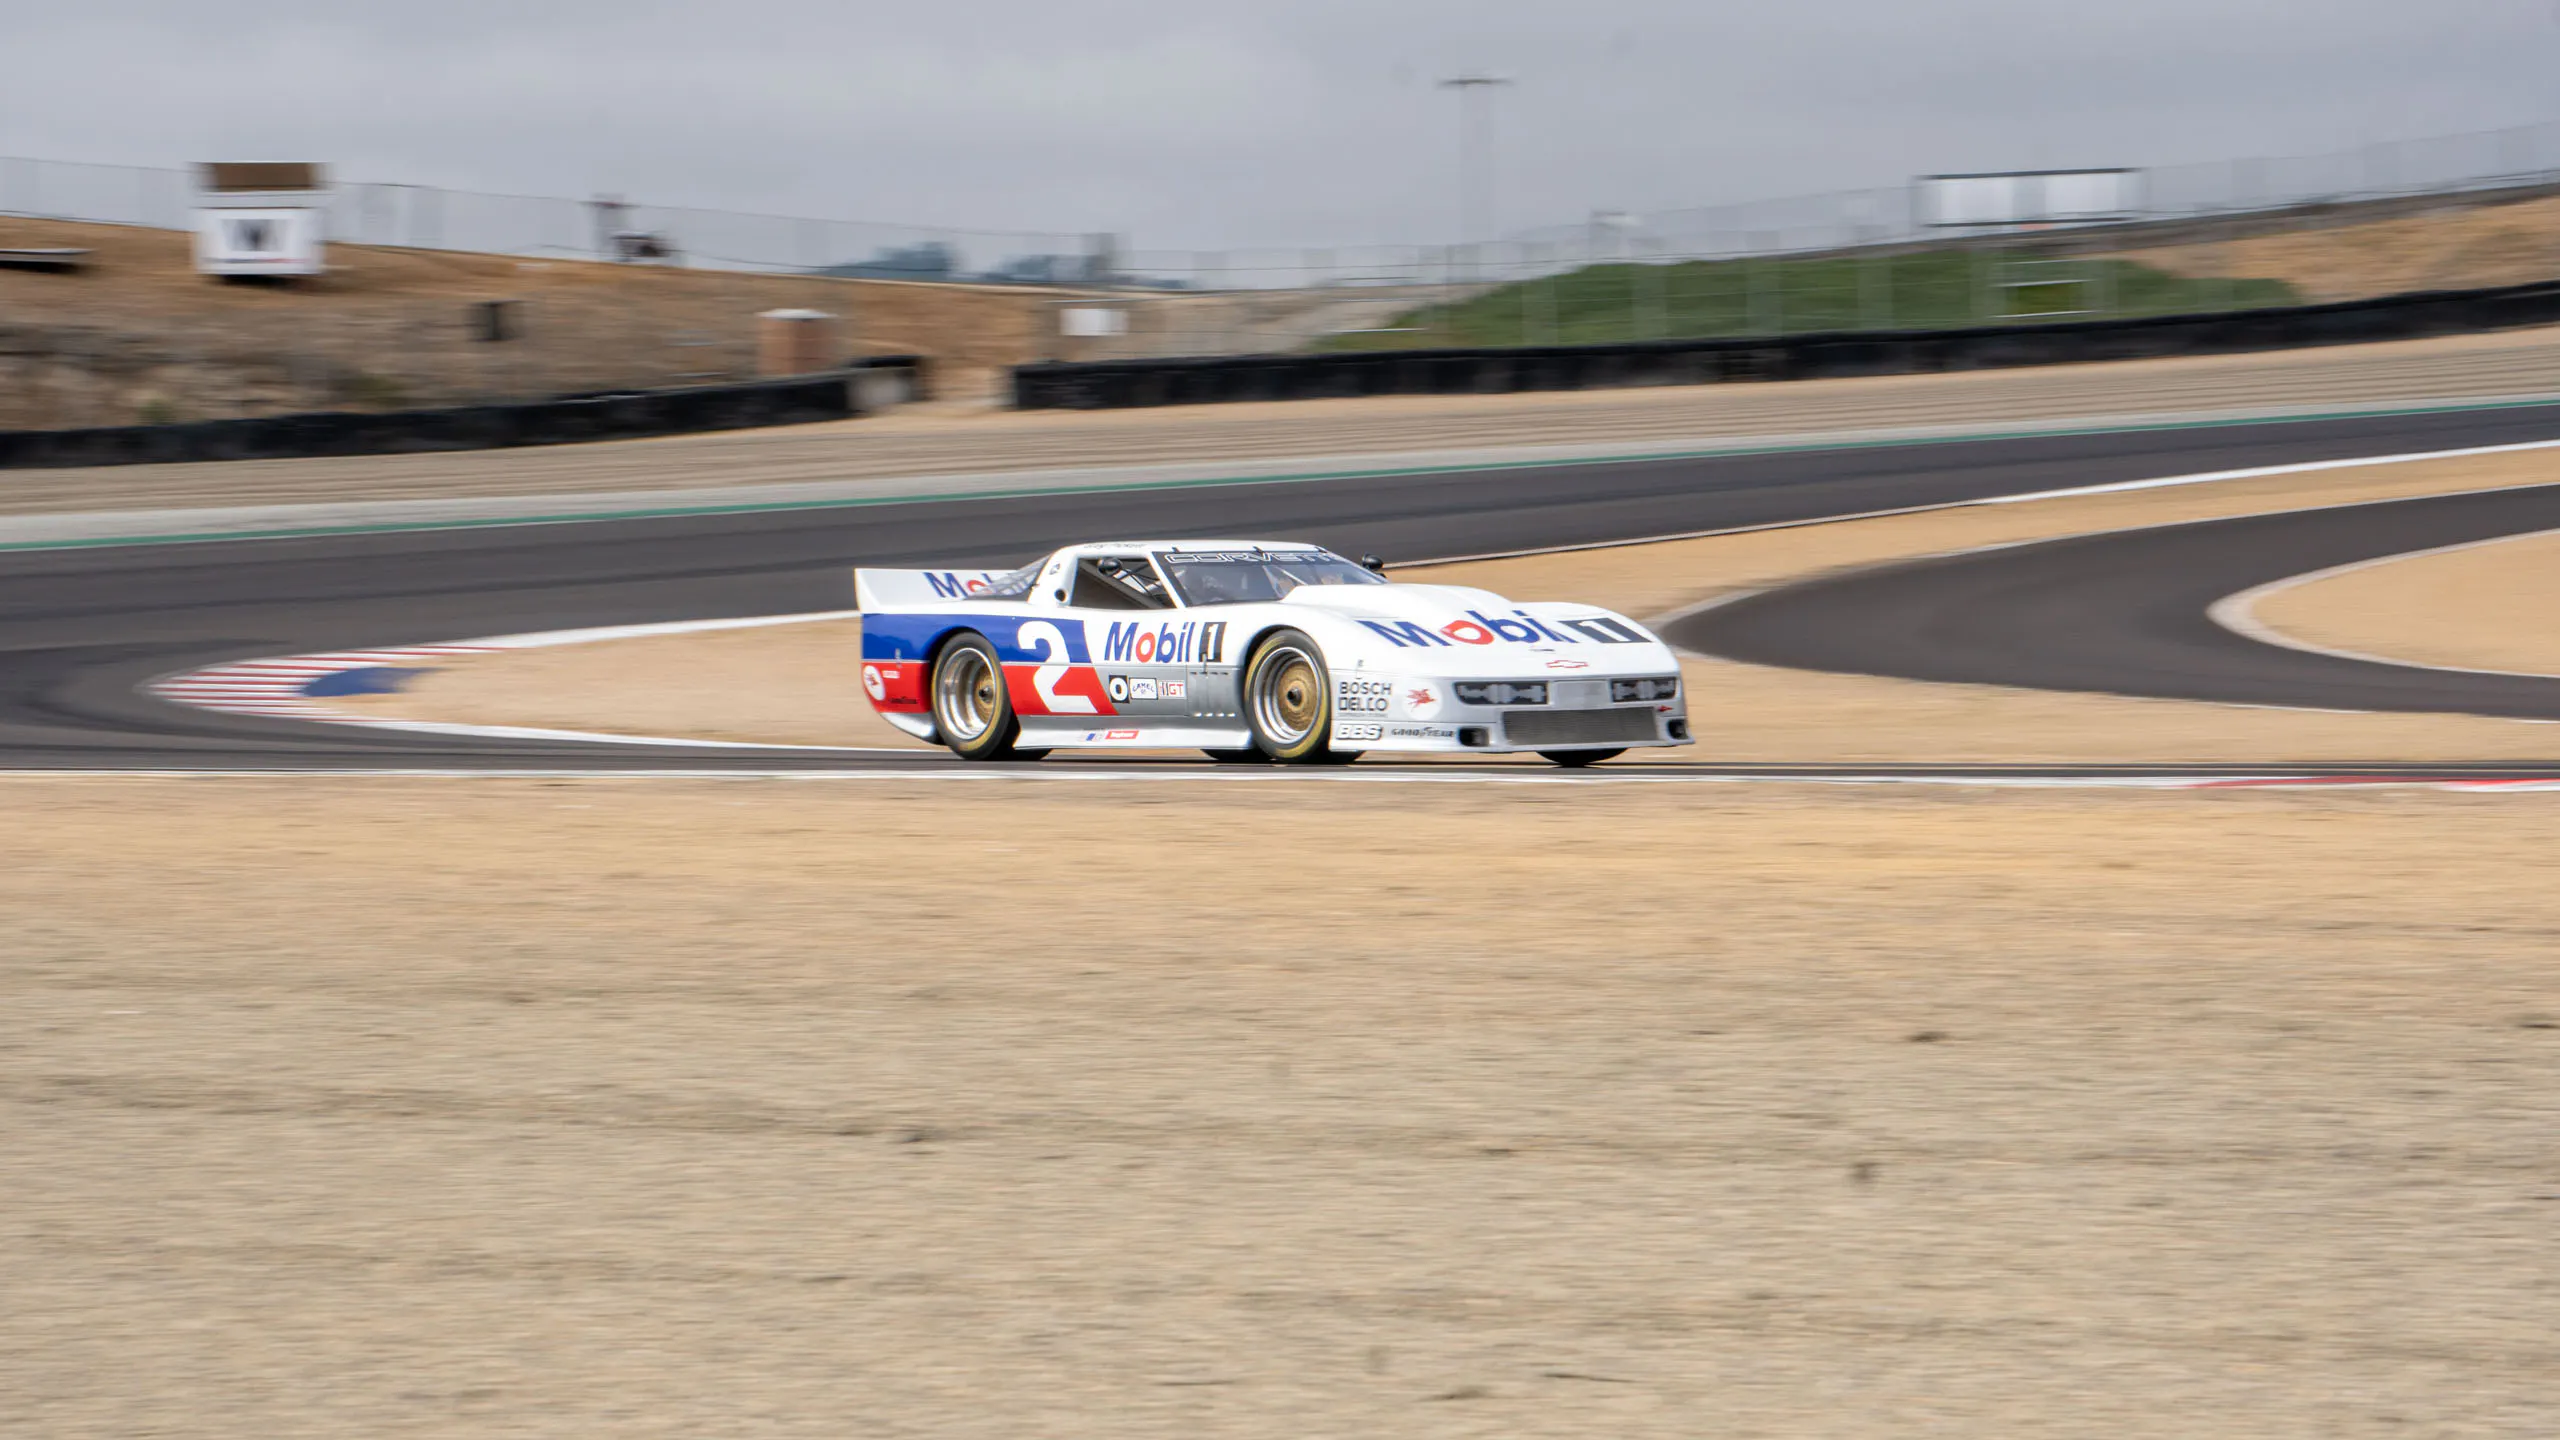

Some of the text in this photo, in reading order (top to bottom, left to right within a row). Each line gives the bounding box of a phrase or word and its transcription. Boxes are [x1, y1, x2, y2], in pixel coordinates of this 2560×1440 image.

[1164, 551, 1332, 565] CORVETT
[1573, 618, 1641, 643] 1
[1104, 621, 1196, 663] Mobil
[1017, 620, 1099, 714] 2
[1340, 681, 1392, 696] BOSCH
[1338, 697, 1388, 711] DELCO
[1336, 723, 1384, 741] BBS
